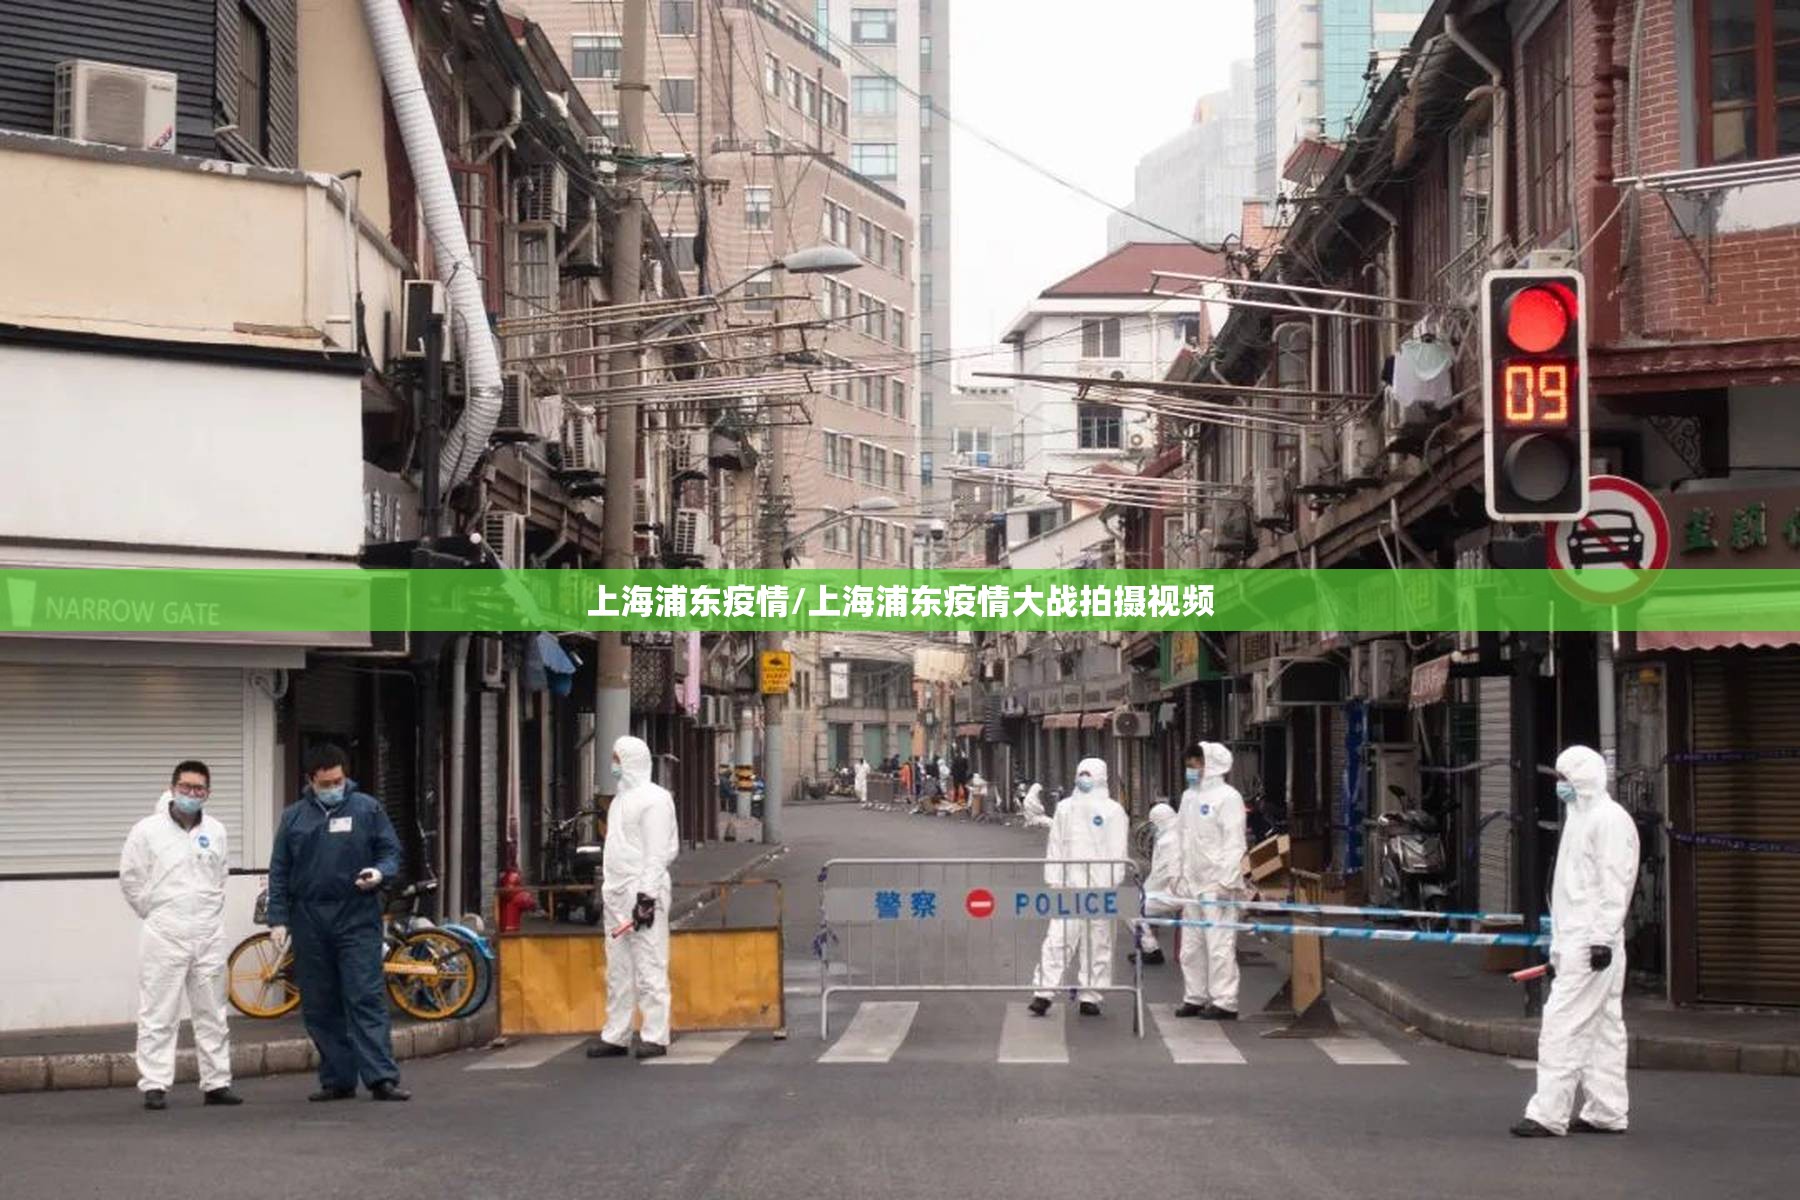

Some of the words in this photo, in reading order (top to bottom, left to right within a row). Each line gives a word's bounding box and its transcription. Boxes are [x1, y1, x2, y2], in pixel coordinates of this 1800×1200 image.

[1506, 366, 1567, 420] 09
[46, 596, 154, 623] NARROW
[162, 601, 221, 626] GATE
[875, 890, 937, 919] 警察
[1015, 891, 1118, 915] POLICE
